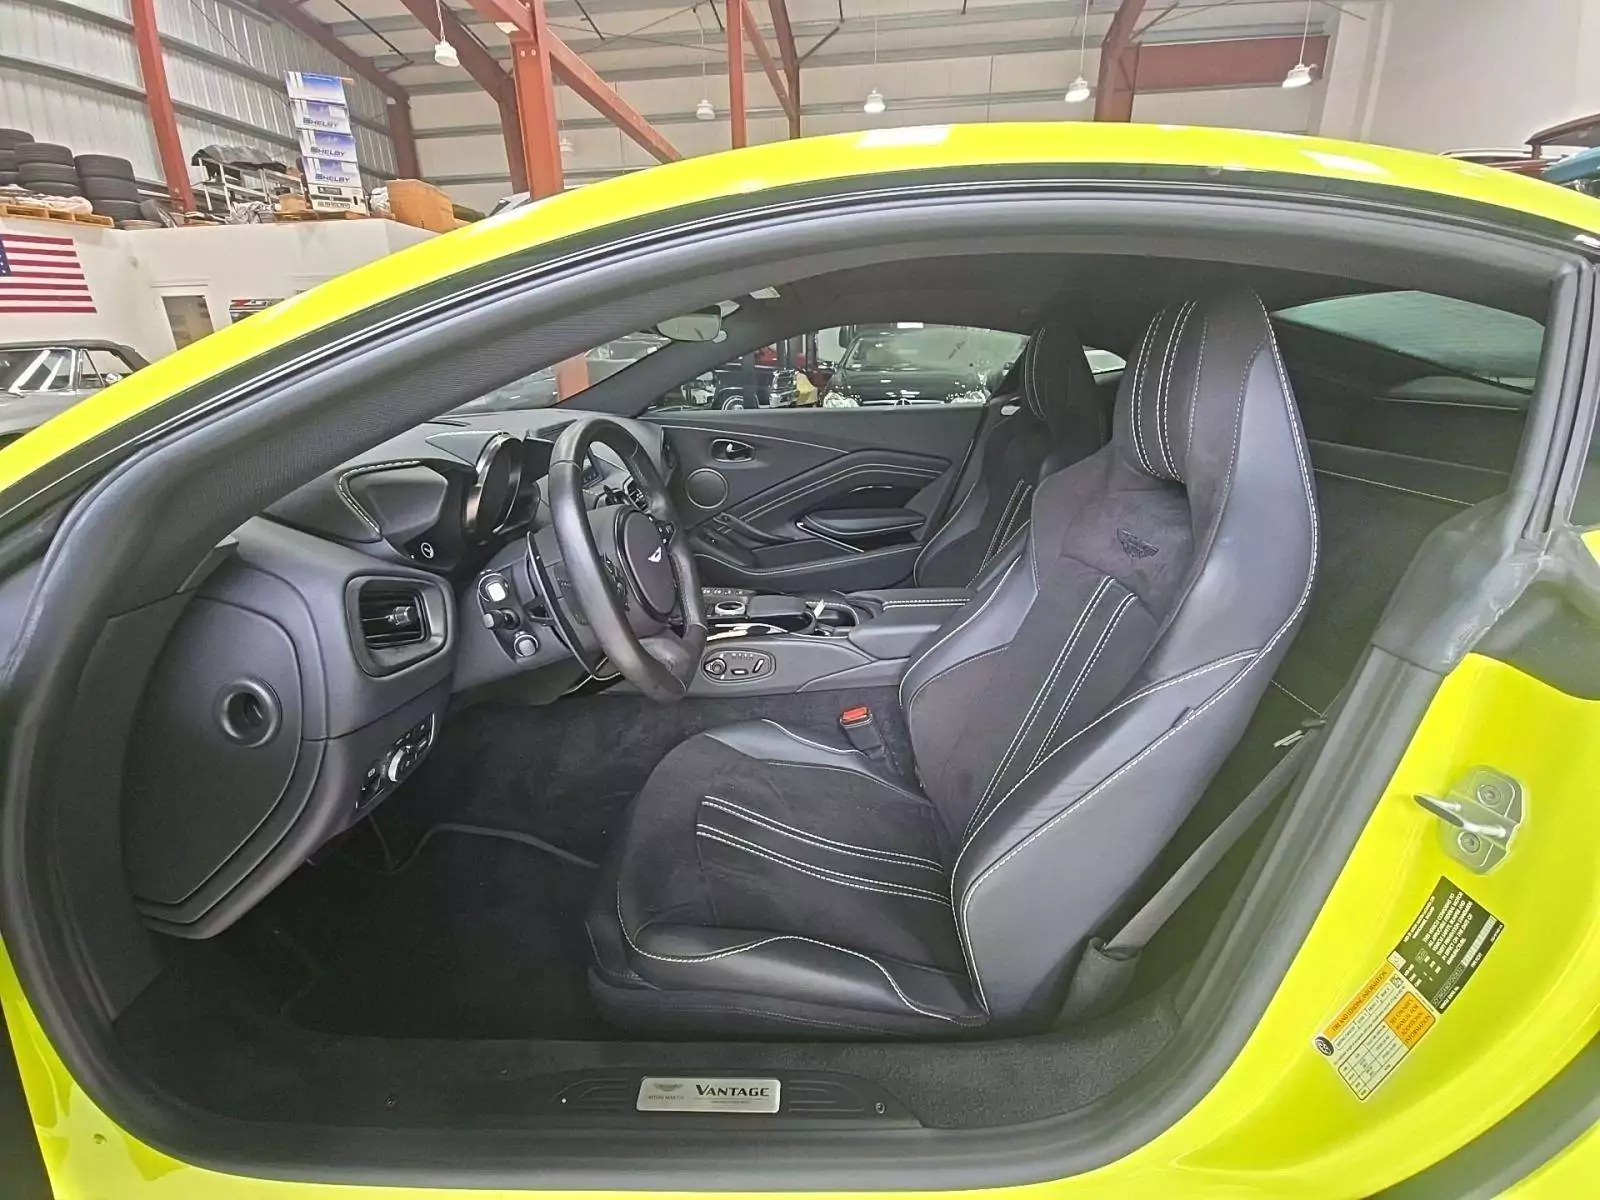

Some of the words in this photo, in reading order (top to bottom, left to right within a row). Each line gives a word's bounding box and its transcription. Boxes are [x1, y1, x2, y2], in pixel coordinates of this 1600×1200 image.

[310, 146, 345, 156] SHELBY
[315, 173, 350, 183] SHELBY
[696, 1084, 770, 1097] VANTAGE
